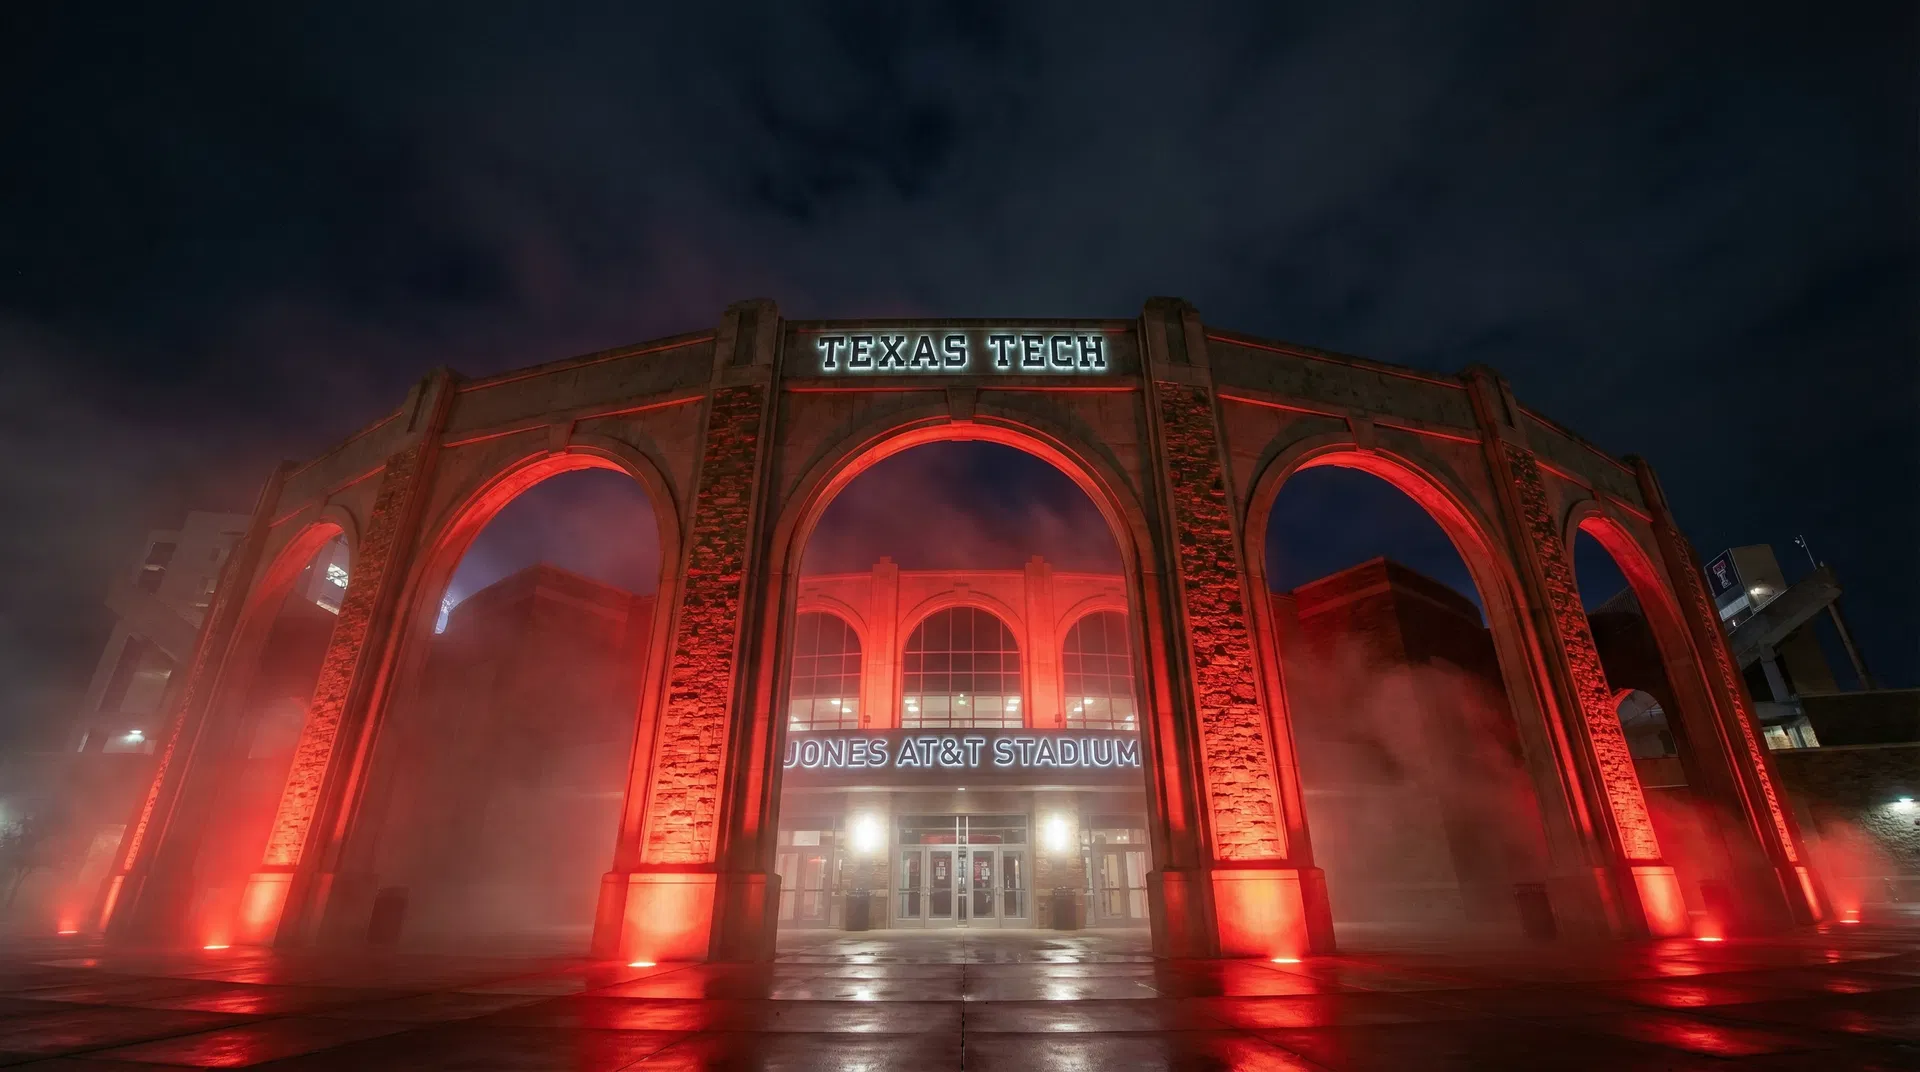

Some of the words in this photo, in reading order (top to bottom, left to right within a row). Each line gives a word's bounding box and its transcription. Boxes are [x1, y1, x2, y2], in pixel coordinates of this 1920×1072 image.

[818, 335, 968, 369] TEXAS
[988, 334, 1107, 368] TECH
[783, 738, 889, 768] JONES
[897, 737, 985, 767] AT&T
[994, 737, 1140, 768] STADIUM
